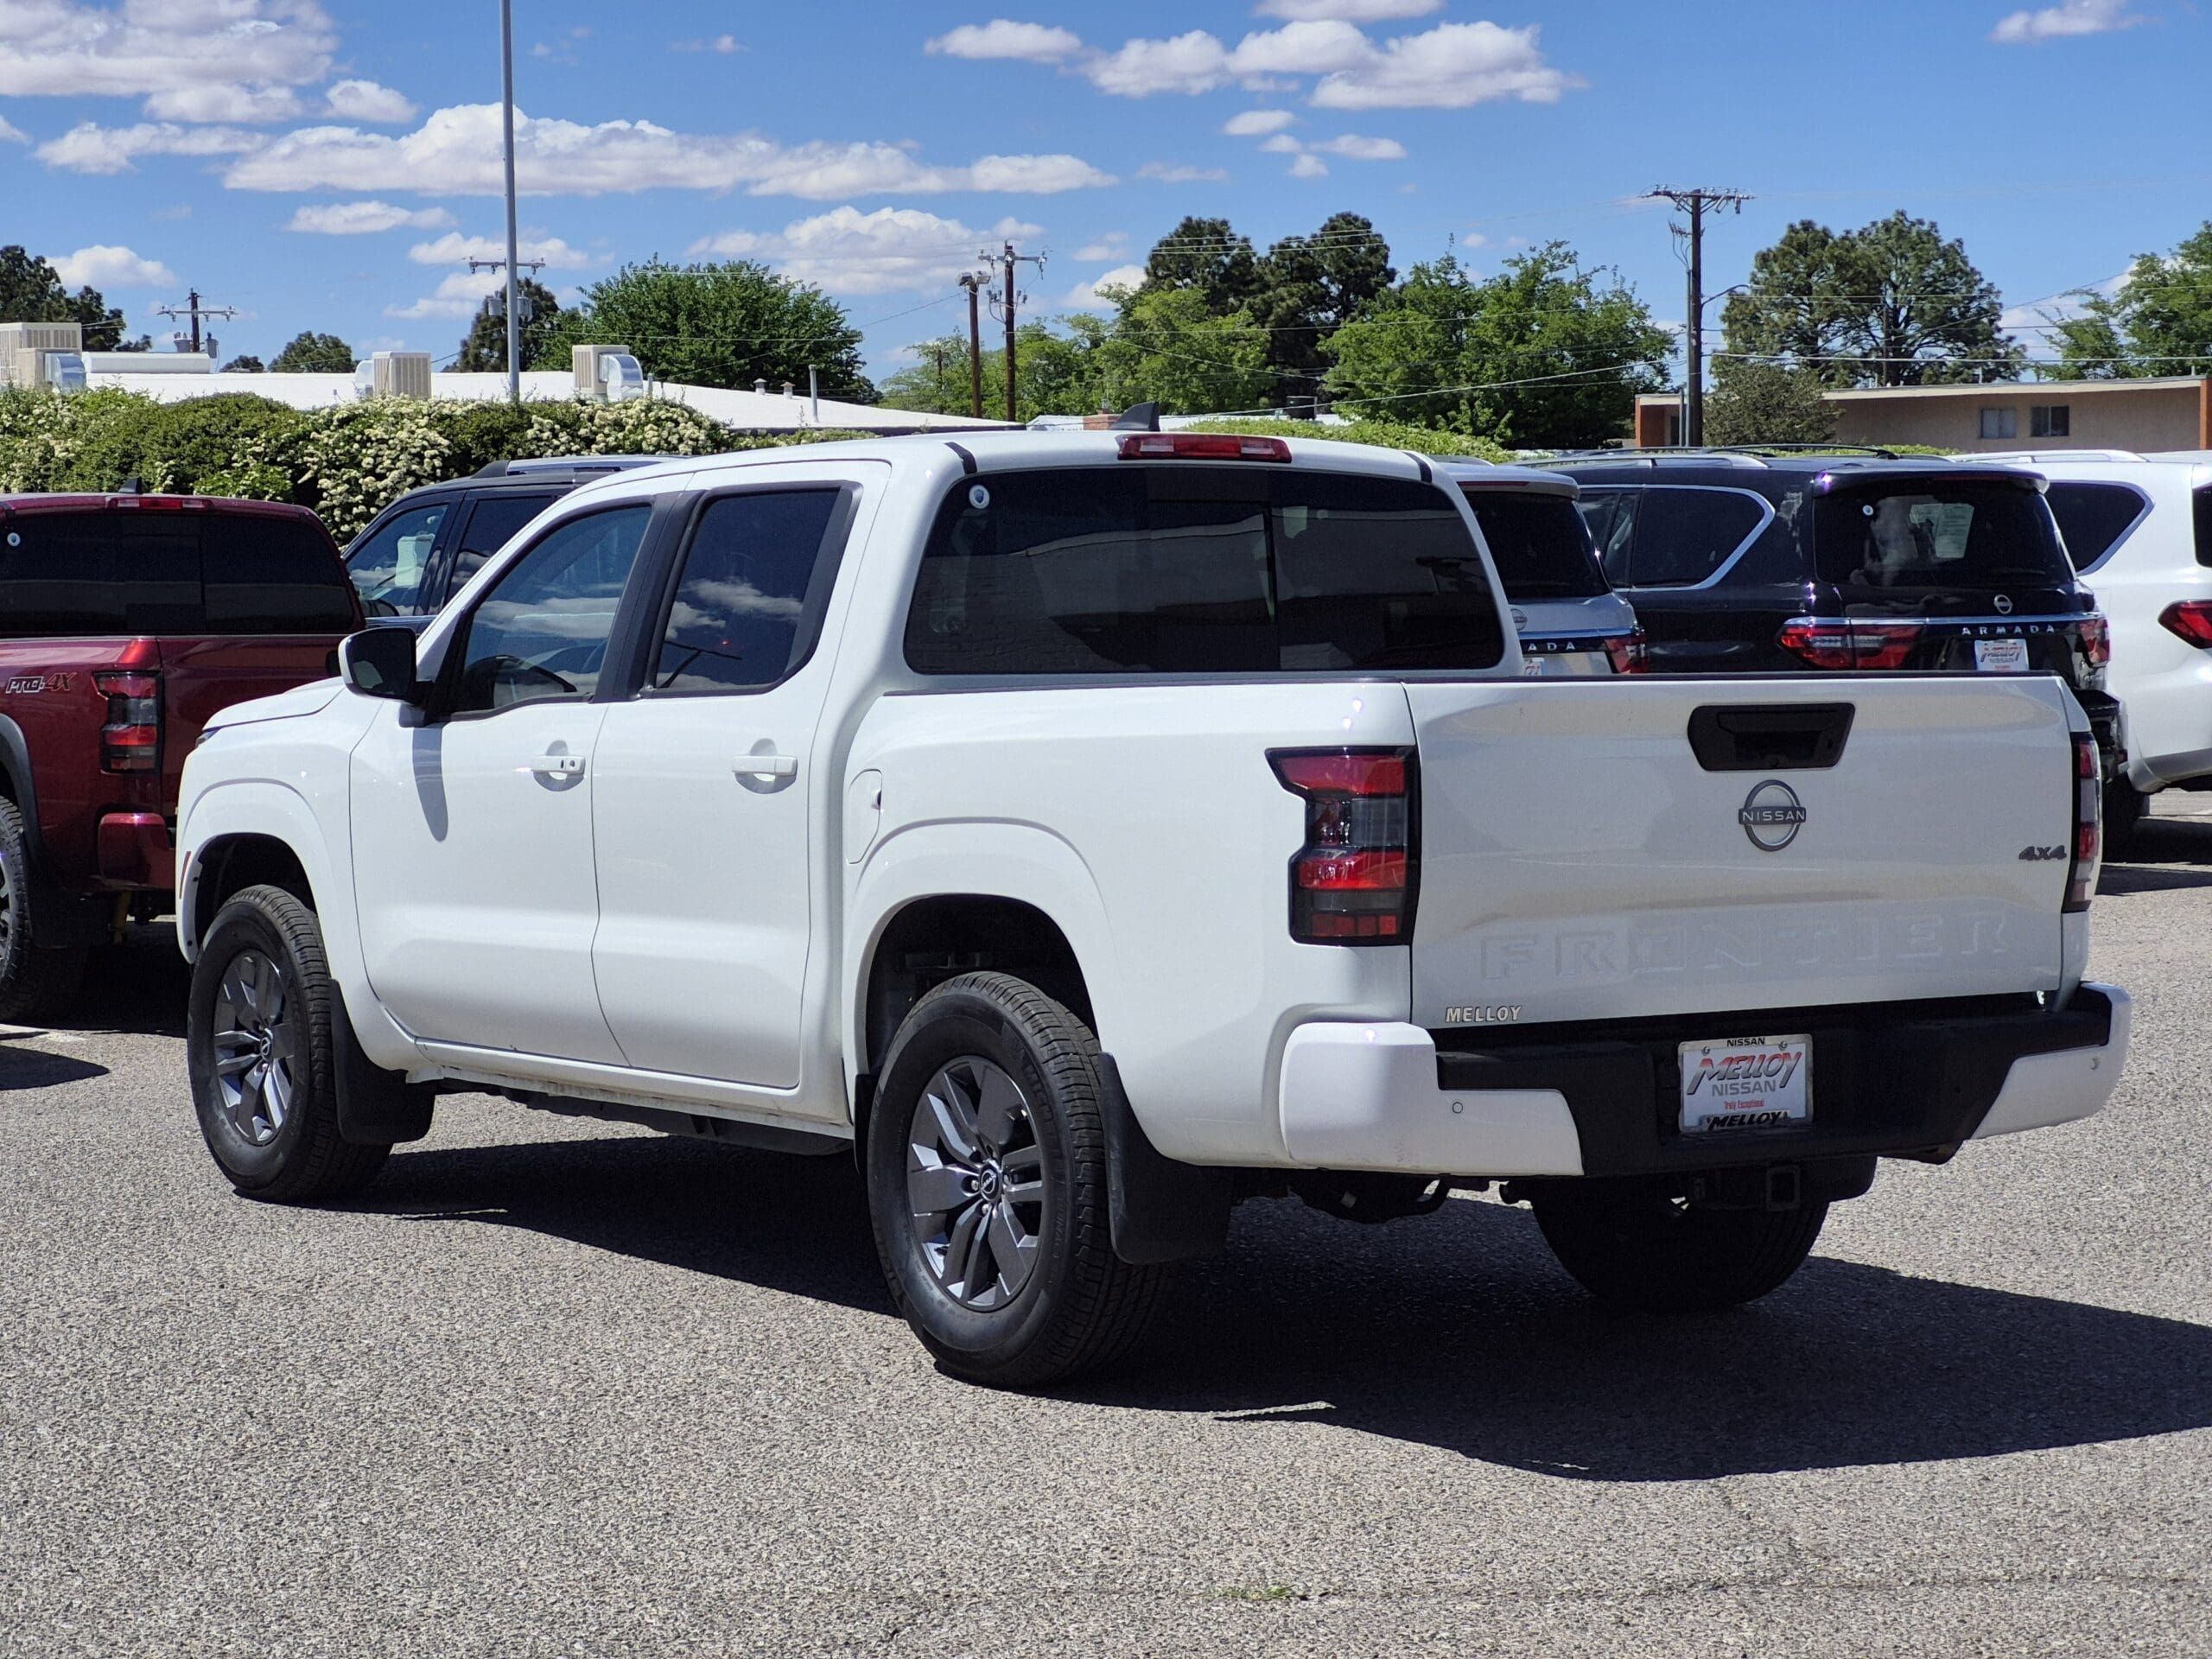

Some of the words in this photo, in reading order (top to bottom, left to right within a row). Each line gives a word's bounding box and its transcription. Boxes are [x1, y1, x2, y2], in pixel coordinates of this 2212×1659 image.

[1961, 625, 2056, 636] ARMADA
[1741, 810, 1806, 822] NISSAN
[1480, 912, 2010, 981] FRONTIER
[1445, 1005, 1522, 1023] MELLOY
[1726, 1037, 1765, 1047] NISSAN
[1687, 1052, 1802, 1095] MELLOY
[1712, 1079, 1777, 1096] NISSAN
[1707, 1111, 1781, 1131] MELLOY
